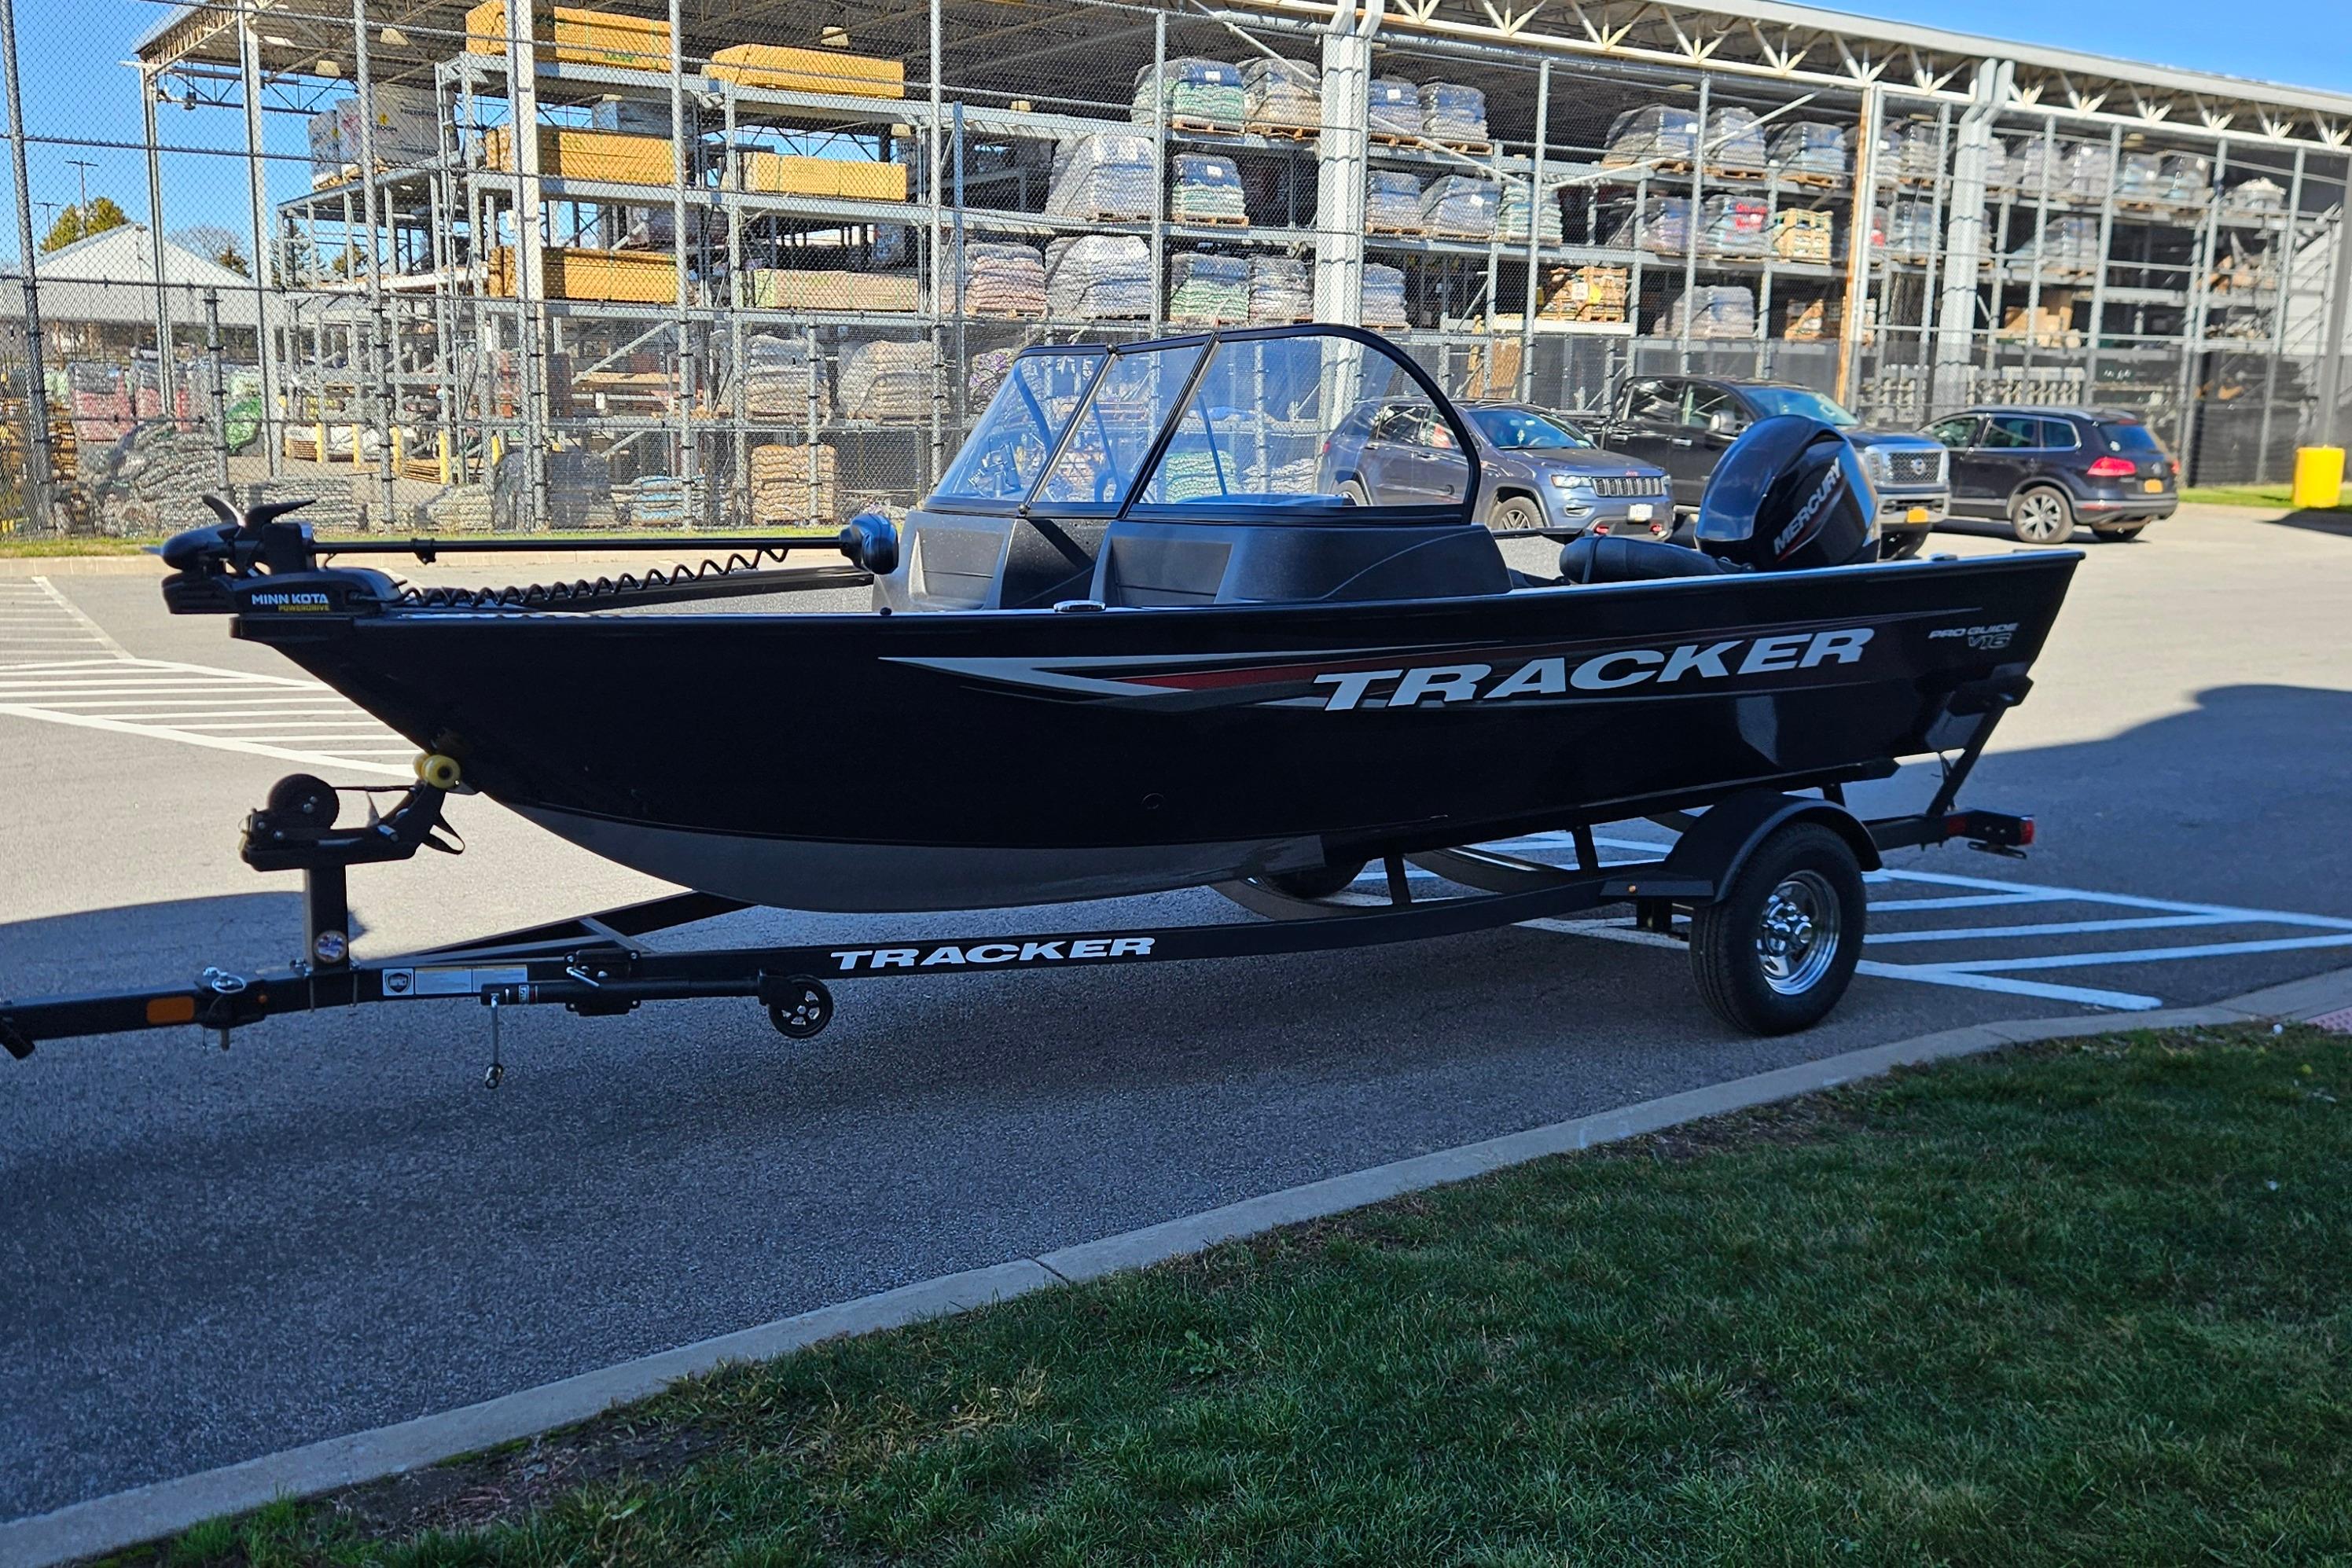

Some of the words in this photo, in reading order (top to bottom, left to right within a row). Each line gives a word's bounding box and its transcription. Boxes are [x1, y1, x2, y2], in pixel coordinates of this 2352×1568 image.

[1773, 457, 1840, 555] MERCURY
[252, 593, 289, 604] MINN
[291, 593, 329, 604] KOTA
[1928, 629, 1966, 639] PRO
[1967, 622, 2019, 635] GUIDE
[1314, 628, 1875, 711] TRACKER
[830, 938, 1156, 970] TRACKER
